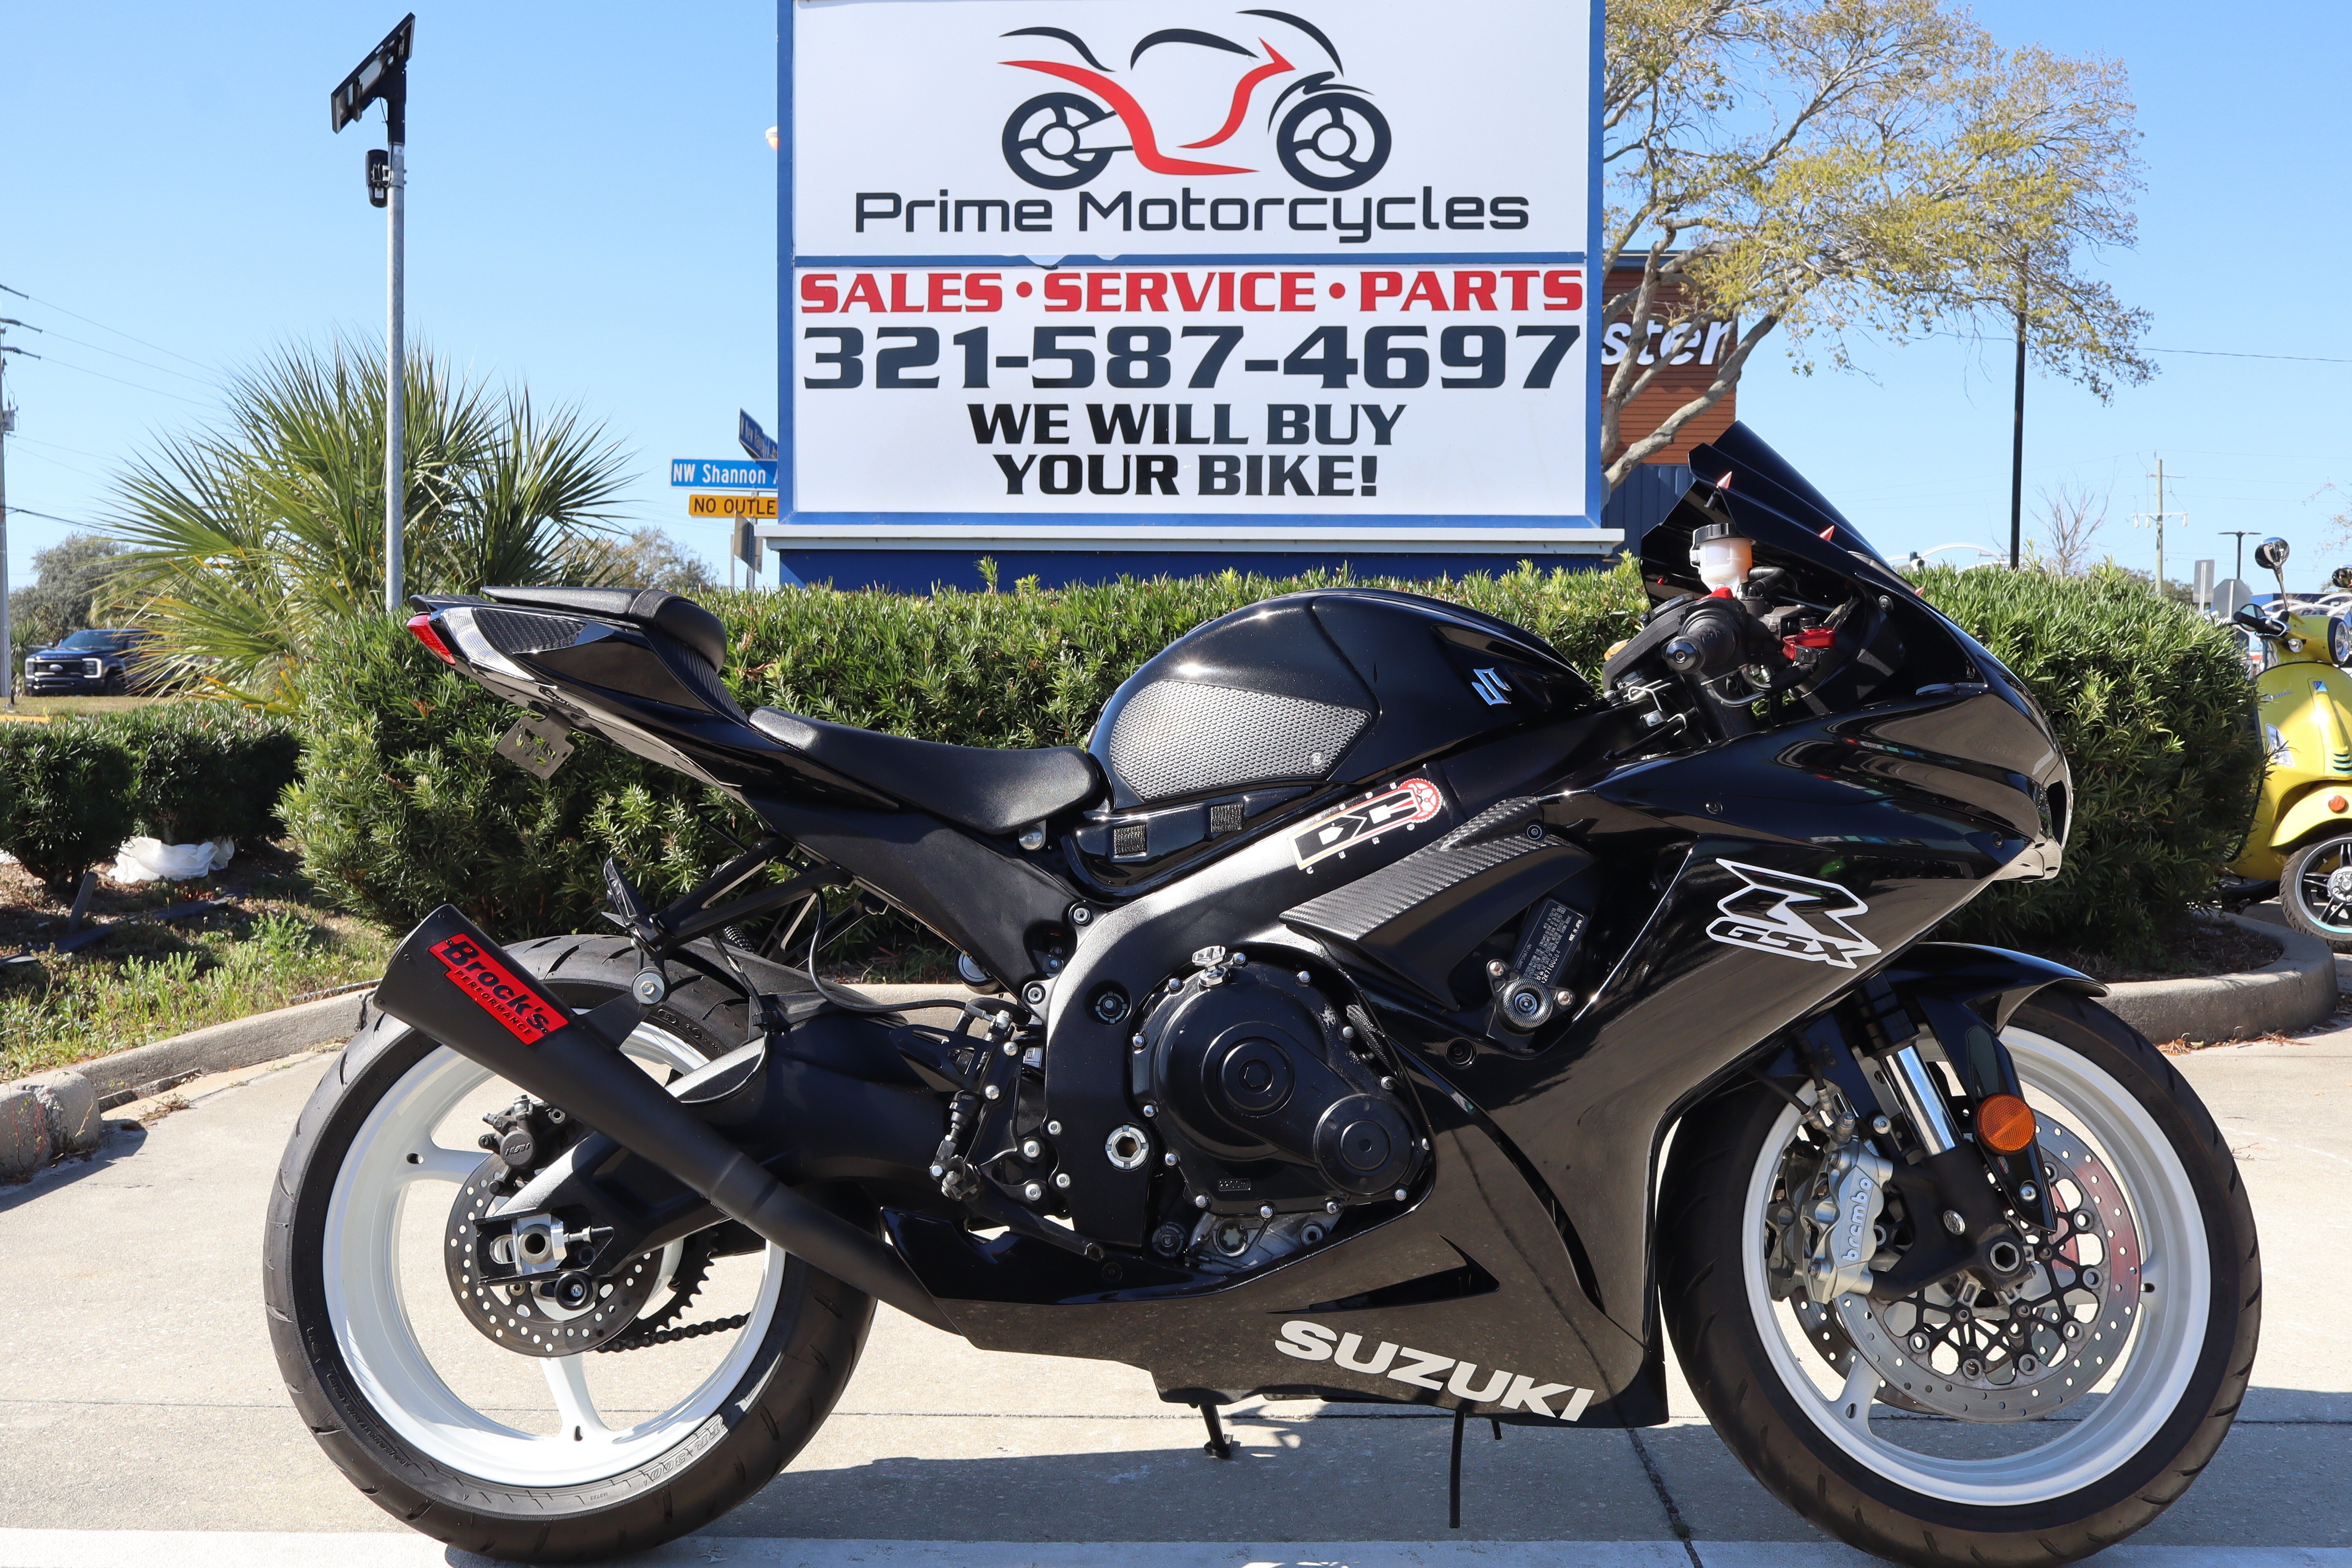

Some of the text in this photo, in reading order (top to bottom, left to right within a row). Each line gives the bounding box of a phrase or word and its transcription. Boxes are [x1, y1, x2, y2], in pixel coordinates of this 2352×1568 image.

[856, 186, 1529, 243] Prime Motorcycles
[802, 270, 1582, 312] SALES SERVICE PARTS
[804, 326, 1580, 388] 321-587-4697
[1602, 320, 1732, 365] ster
[967, 404, 1406, 445] WE WILL BUY
[673, 464, 695, 482] NW
[702, 464, 766, 484] Shannon
[993, 455, 1377, 496] YOUR BIKE!
[694, 498, 775, 514] NO OUTLE
[1574, 919, 1582, 929] JAPAN
[440, 940, 549, 1030] Brock's
[454, 970, 532, 1036] PERFORMANCE
[1842, 1178, 1872, 1261] brembo
[1275, 1320, 1595, 1422] SUZUKI
